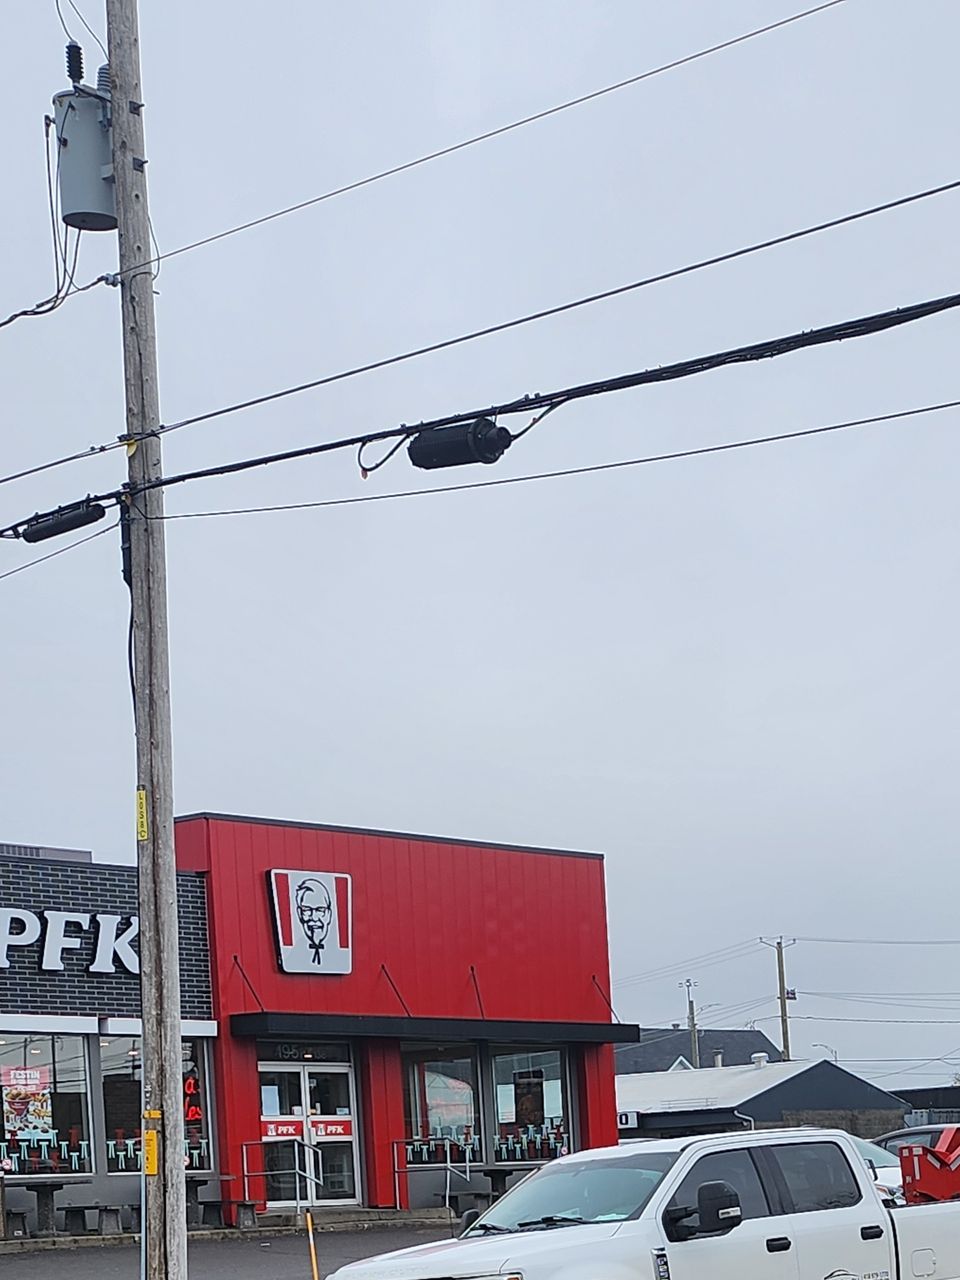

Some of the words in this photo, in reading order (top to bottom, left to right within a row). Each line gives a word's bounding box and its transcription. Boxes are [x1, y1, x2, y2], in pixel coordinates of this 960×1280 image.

[0, 907, 140, 974] PFK
[277, 1125, 296, 1134] PFK
[326, 1125, 345, 1134] PFK
